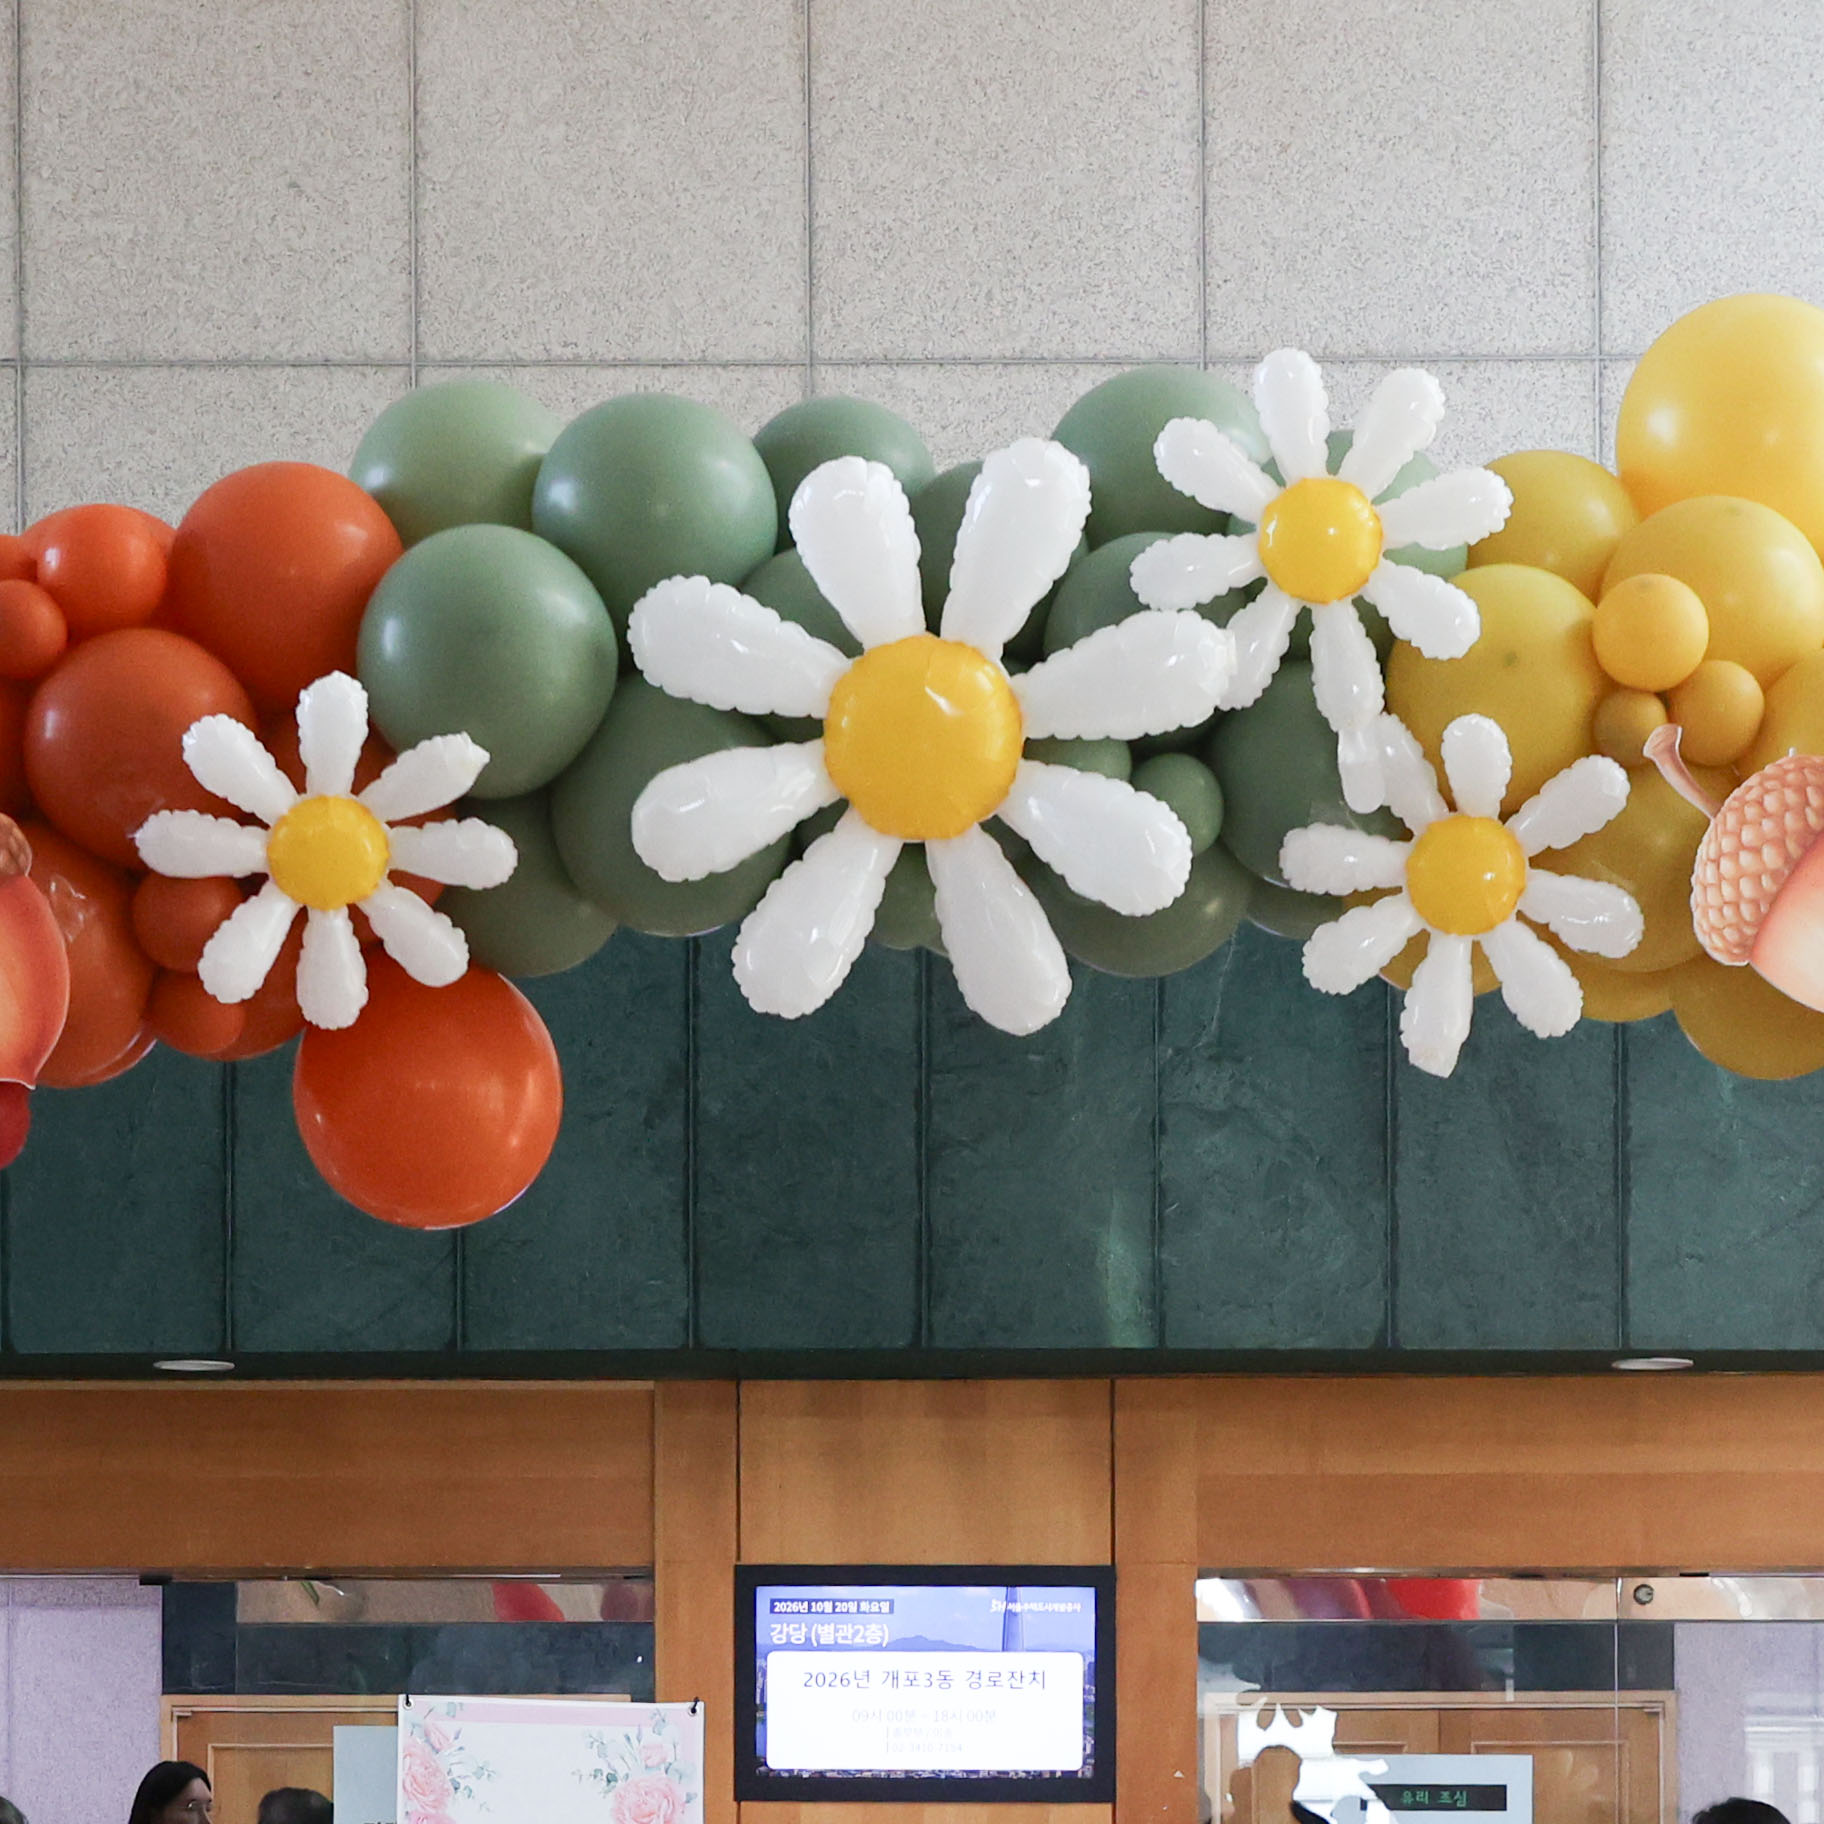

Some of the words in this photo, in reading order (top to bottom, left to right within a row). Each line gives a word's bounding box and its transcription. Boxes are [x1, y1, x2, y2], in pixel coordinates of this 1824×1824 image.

[774, 1600, 808, 1613] 2026년
[811, 1600, 833, 1613] 10월
[835, 1600, 857, 1613] 20일
[860, 1600, 890, 1613] 화요일
[770, 1622, 808, 1645] 강당
[810, 1623, 889, 1647] (별관2층)
[802, 1669, 871, 1689] 2026년
[882, 1669, 954, 1690] 개포3동
[966, 1670, 1046, 1690] 경로잔치
[1399, 1790, 1429, 1805] 유리
[1437, 1790, 1469, 1808] 조심
